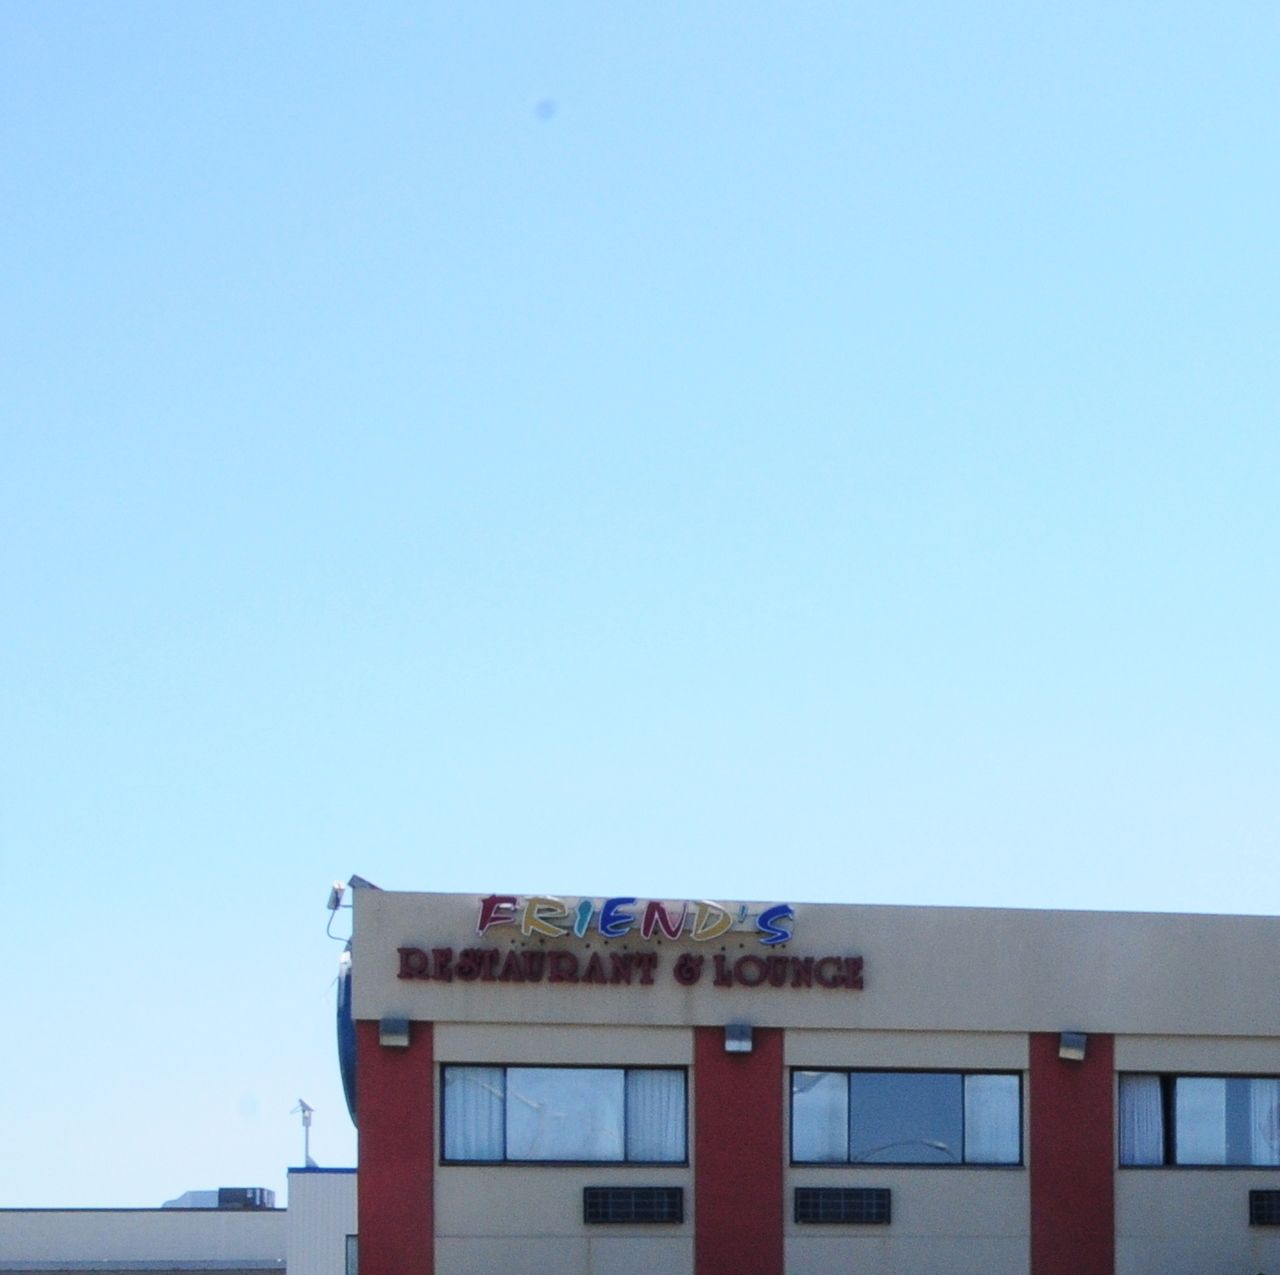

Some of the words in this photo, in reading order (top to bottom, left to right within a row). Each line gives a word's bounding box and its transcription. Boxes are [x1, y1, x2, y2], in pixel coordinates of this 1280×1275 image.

[476, 895, 795, 945] FRIEND'S
[397, 947, 658, 986] RESTAURANT
[673, 949, 706, 986] &
[713, 953, 865, 991] LOUNGE
